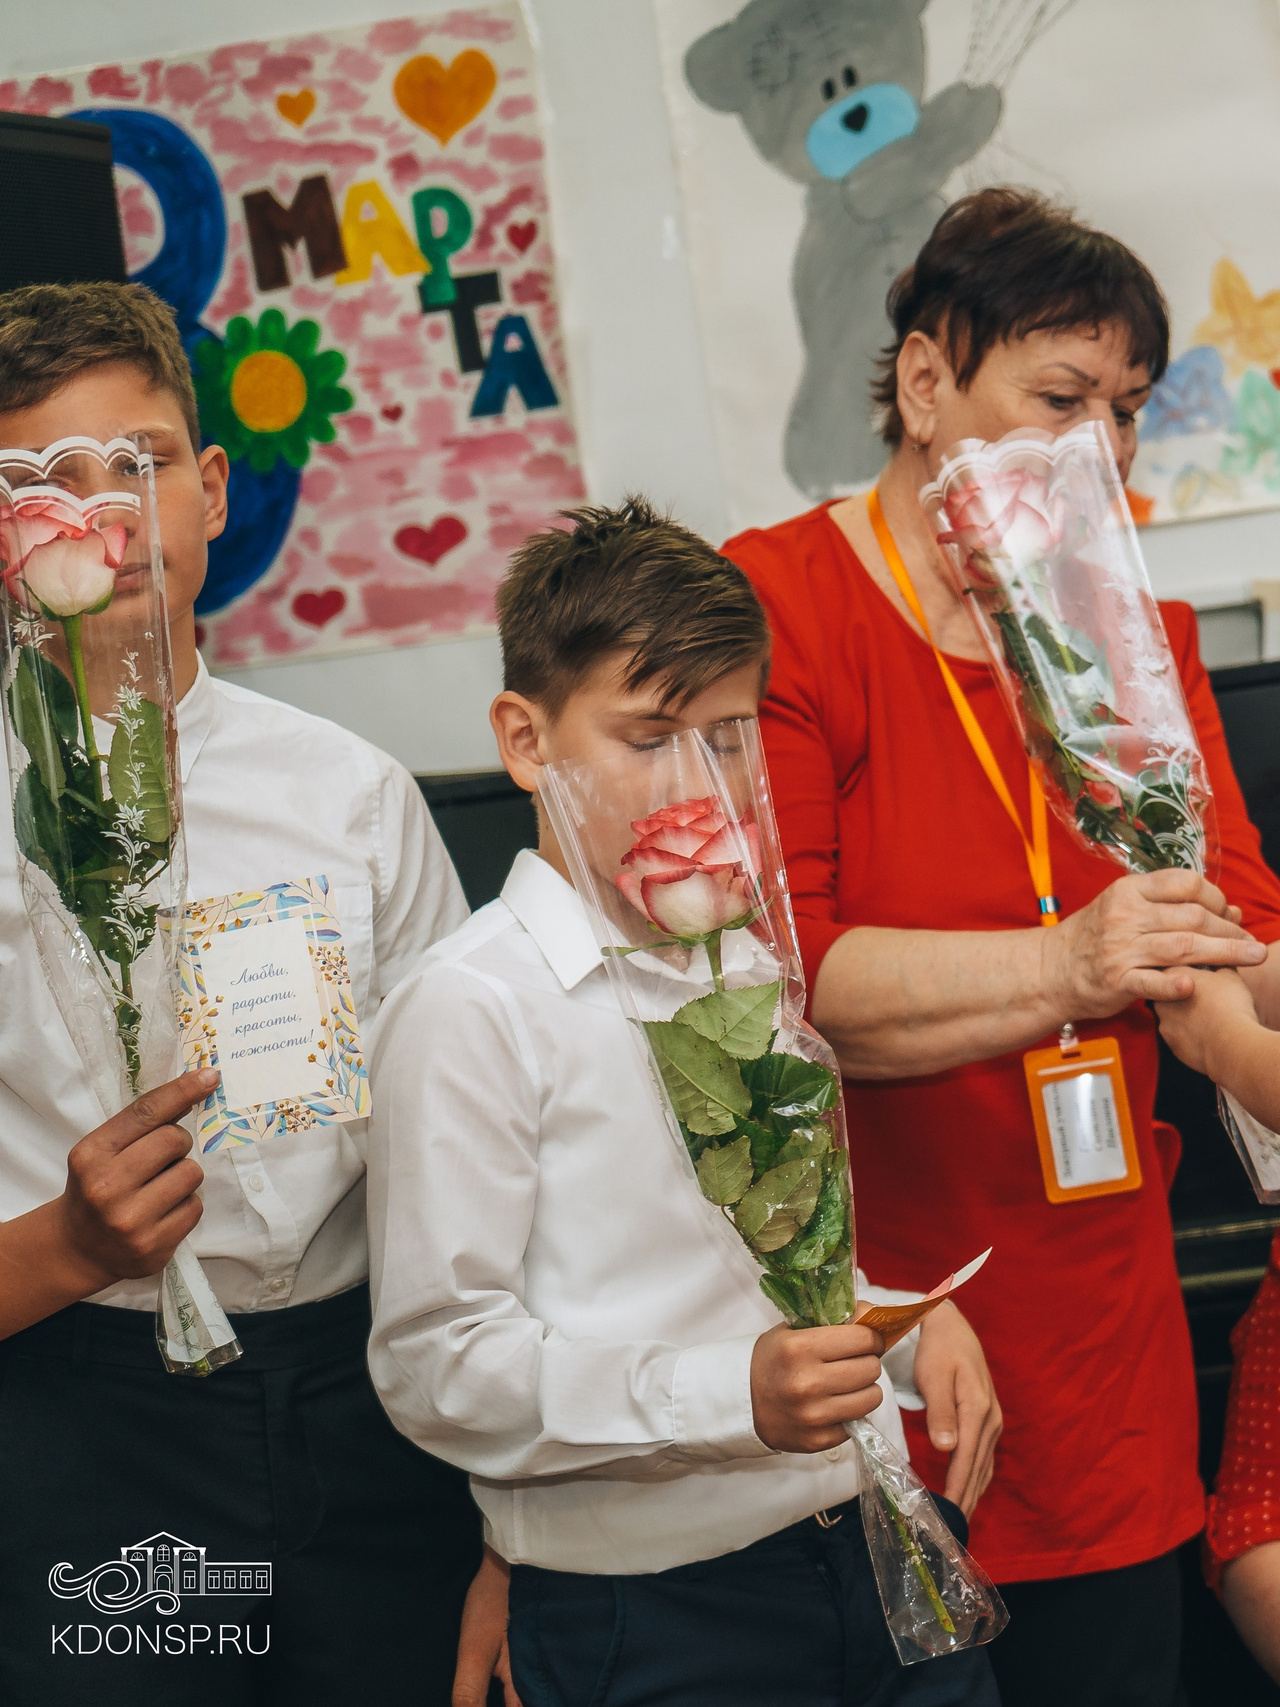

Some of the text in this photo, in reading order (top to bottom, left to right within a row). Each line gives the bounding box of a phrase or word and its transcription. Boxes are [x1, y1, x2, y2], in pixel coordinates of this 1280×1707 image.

[241, 173, 560, 420] МАРТА
[230, 963, 290, 986] Любви,
[231, 990, 296, 1015] радости,
[235, 1014, 302, 1037] красоты,
[231, 1029, 314, 1059] нежности!
